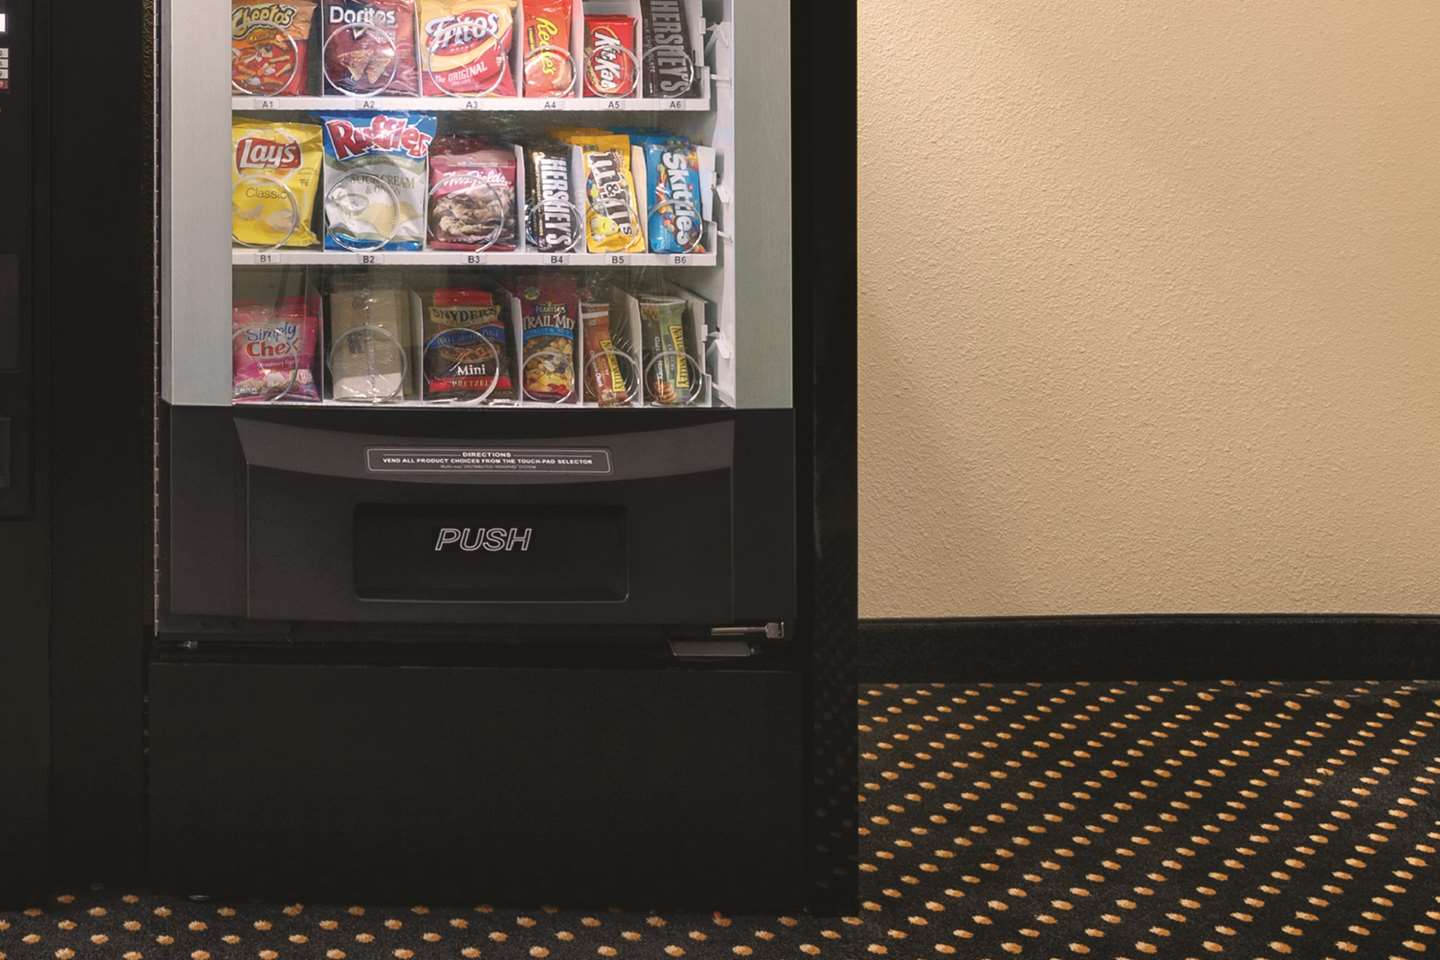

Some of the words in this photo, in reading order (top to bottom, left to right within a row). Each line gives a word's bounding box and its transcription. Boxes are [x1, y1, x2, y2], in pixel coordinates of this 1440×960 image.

[232, 4, 297, 38] Cheetos
[329, 6, 396, 26] Doritos
[425, 13, 499, 52] Fritos
[650, 0, 691, 92] HERSHEY'S
[447, 61, 488, 81] ORIGINAL
[262, 101, 273, 109] A1
[363, 101, 375, 109] A2
[466, 101, 478, 109] A3
[544, 101, 556, 109] A4
[608, 101, 620, 109] A5
[670, 101, 681, 109] A6
[328, 116, 432, 160] Ruffles
[245, 187, 288, 200] Classic
[662, 152, 696, 245] Skittles
[540, 157, 572, 246] HERSHEY'S
[260, 255, 272, 263] B1
[363, 256, 375, 264] B2
[468, 256, 480, 264] B3
[551, 256, 563, 264] B4
[612, 256, 624, 264] B5
[675, 256, 687, 264] B6
[523, 315, 551, 330] TRAIL
[246, 322, 297, 342] Simply
[246, 337, 301, 357] Chex
[457, 363, 486, 376] Mini
[451, 379, 492, 388] PRETZEL
[435, 527, 532, 551] PUSH
